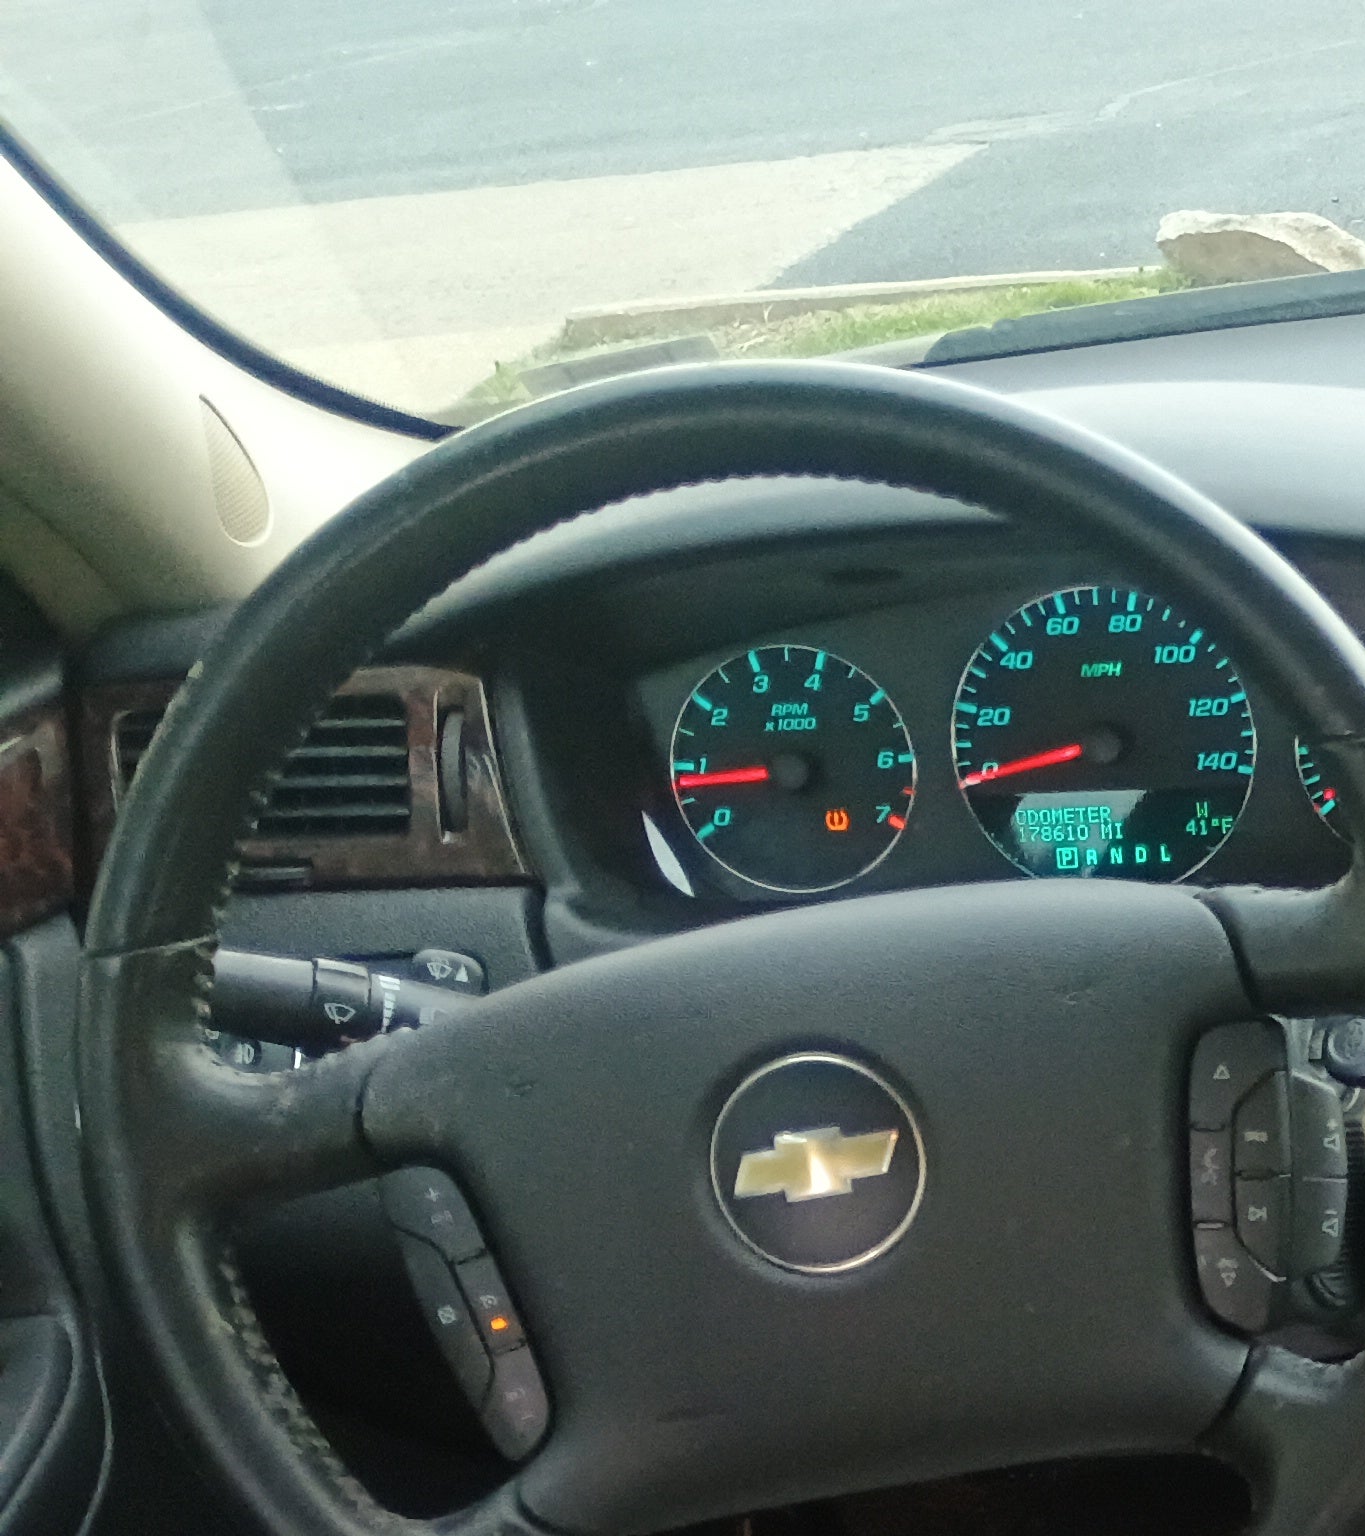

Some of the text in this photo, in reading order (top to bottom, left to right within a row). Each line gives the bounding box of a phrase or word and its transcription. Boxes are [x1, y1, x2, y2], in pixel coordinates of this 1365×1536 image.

[1046, 616, 1080, 636] 60
[1108, 613, 1142, 634] 80
[1000, 650, 1033, 670] 40
[1154, 644, 1196, 664] 100
[1081, 661, 1122, 678] MPH
[752, 676, 770, 693] 3
[804, 675, 821, 691] 4
[711, 708, 728, 727] 2
[770, 702, 809, 716] RPM
[853, 705, 870, 721] 5
[977, 706, 1012, 727] 20
[1188, 698, 1229, 718] 120
[877, 751, 893, 768] 6
[1197, 751, 1238, 771] 140
[714, 808, 730, 824] 0
[875, 806, 891, 822] 7
[1016, 807, 1112, 826] ODOMETER
[1019, 821, 1125, 842] 178610 MI
[1110, 846, 1123, 864] N
[1135, 846, 1148, 863] D
[1160, 845, 1172, 863] L
